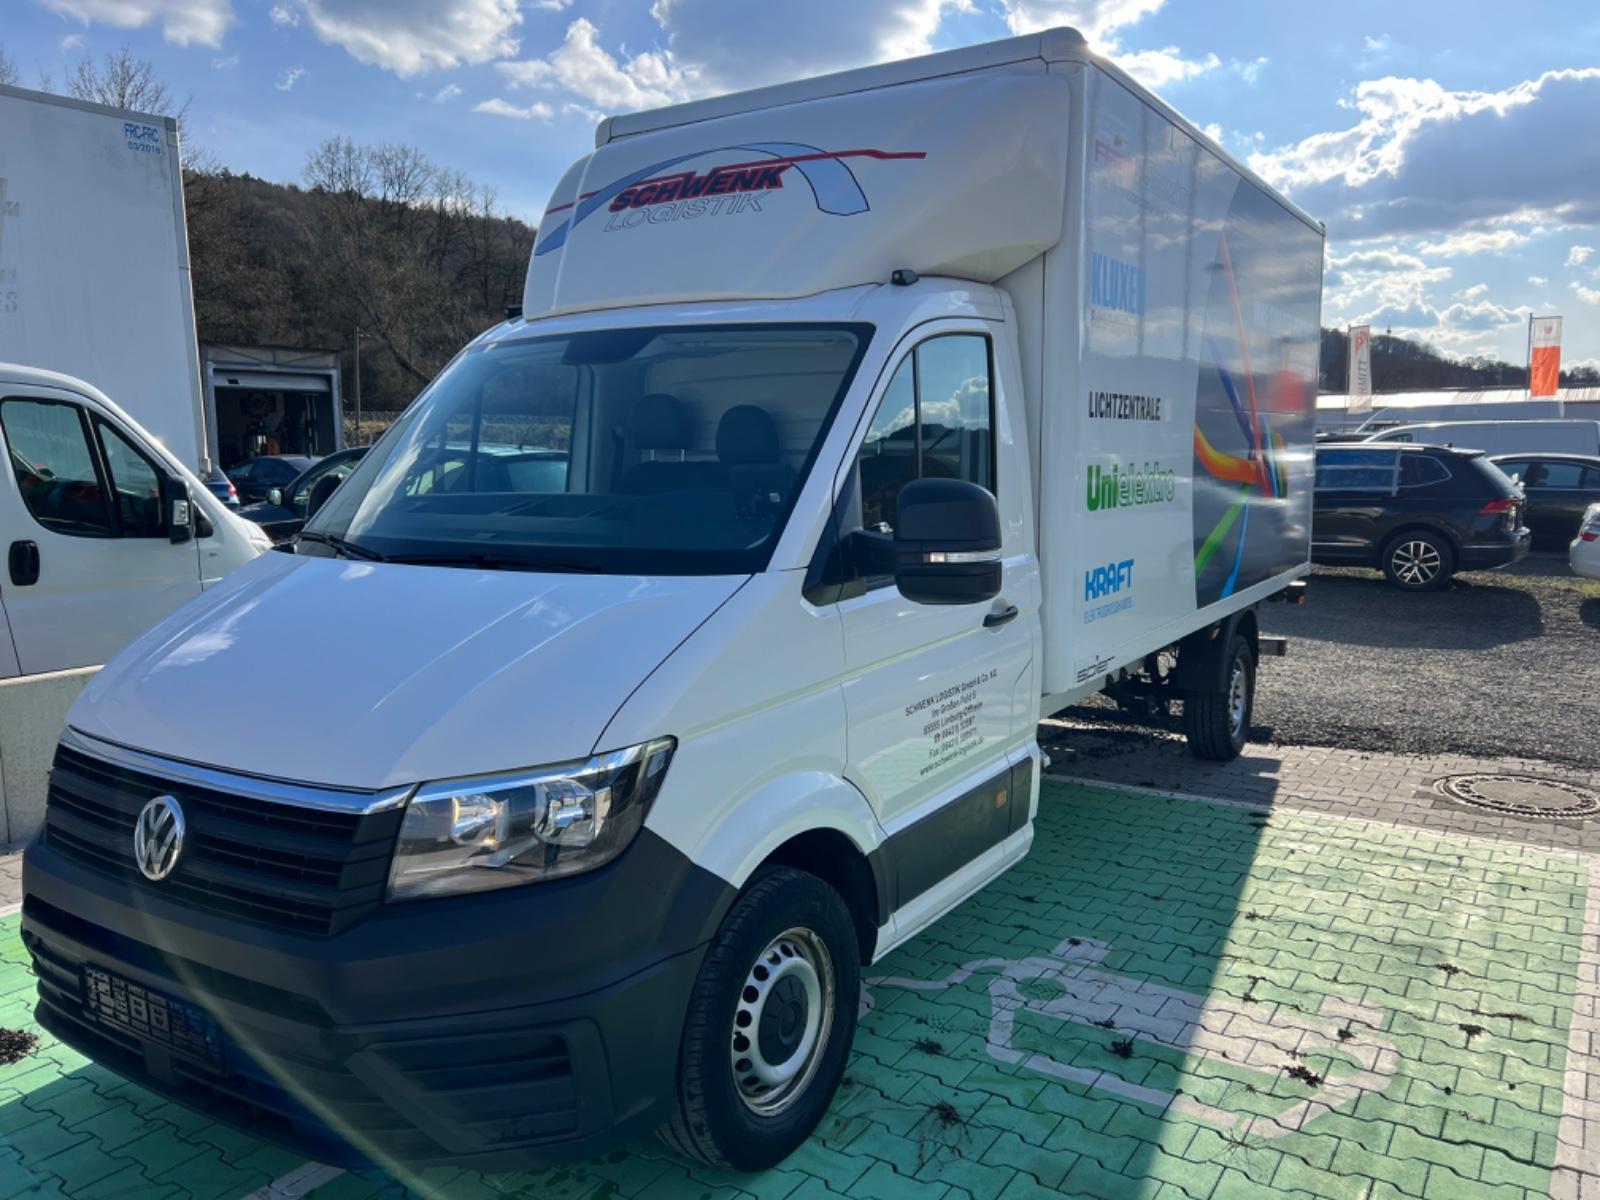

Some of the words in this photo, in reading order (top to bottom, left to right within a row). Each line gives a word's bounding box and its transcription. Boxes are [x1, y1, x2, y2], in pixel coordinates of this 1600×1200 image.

[608, 162, 791, 213] SCHWENK
[603, 189, 774, 232] LOGISTIK
[1089, 391, 1161, 421] LICHTZENTRALE
[1086, 462, 1176, 511] Unielektro
[1084, 559, 1135, 602] KRAFT
[904, 695, 934, 717] SCHWENK
[935, 684, 961, 703] LOGISTIK
[961, 677, 977, 692] GmbH
